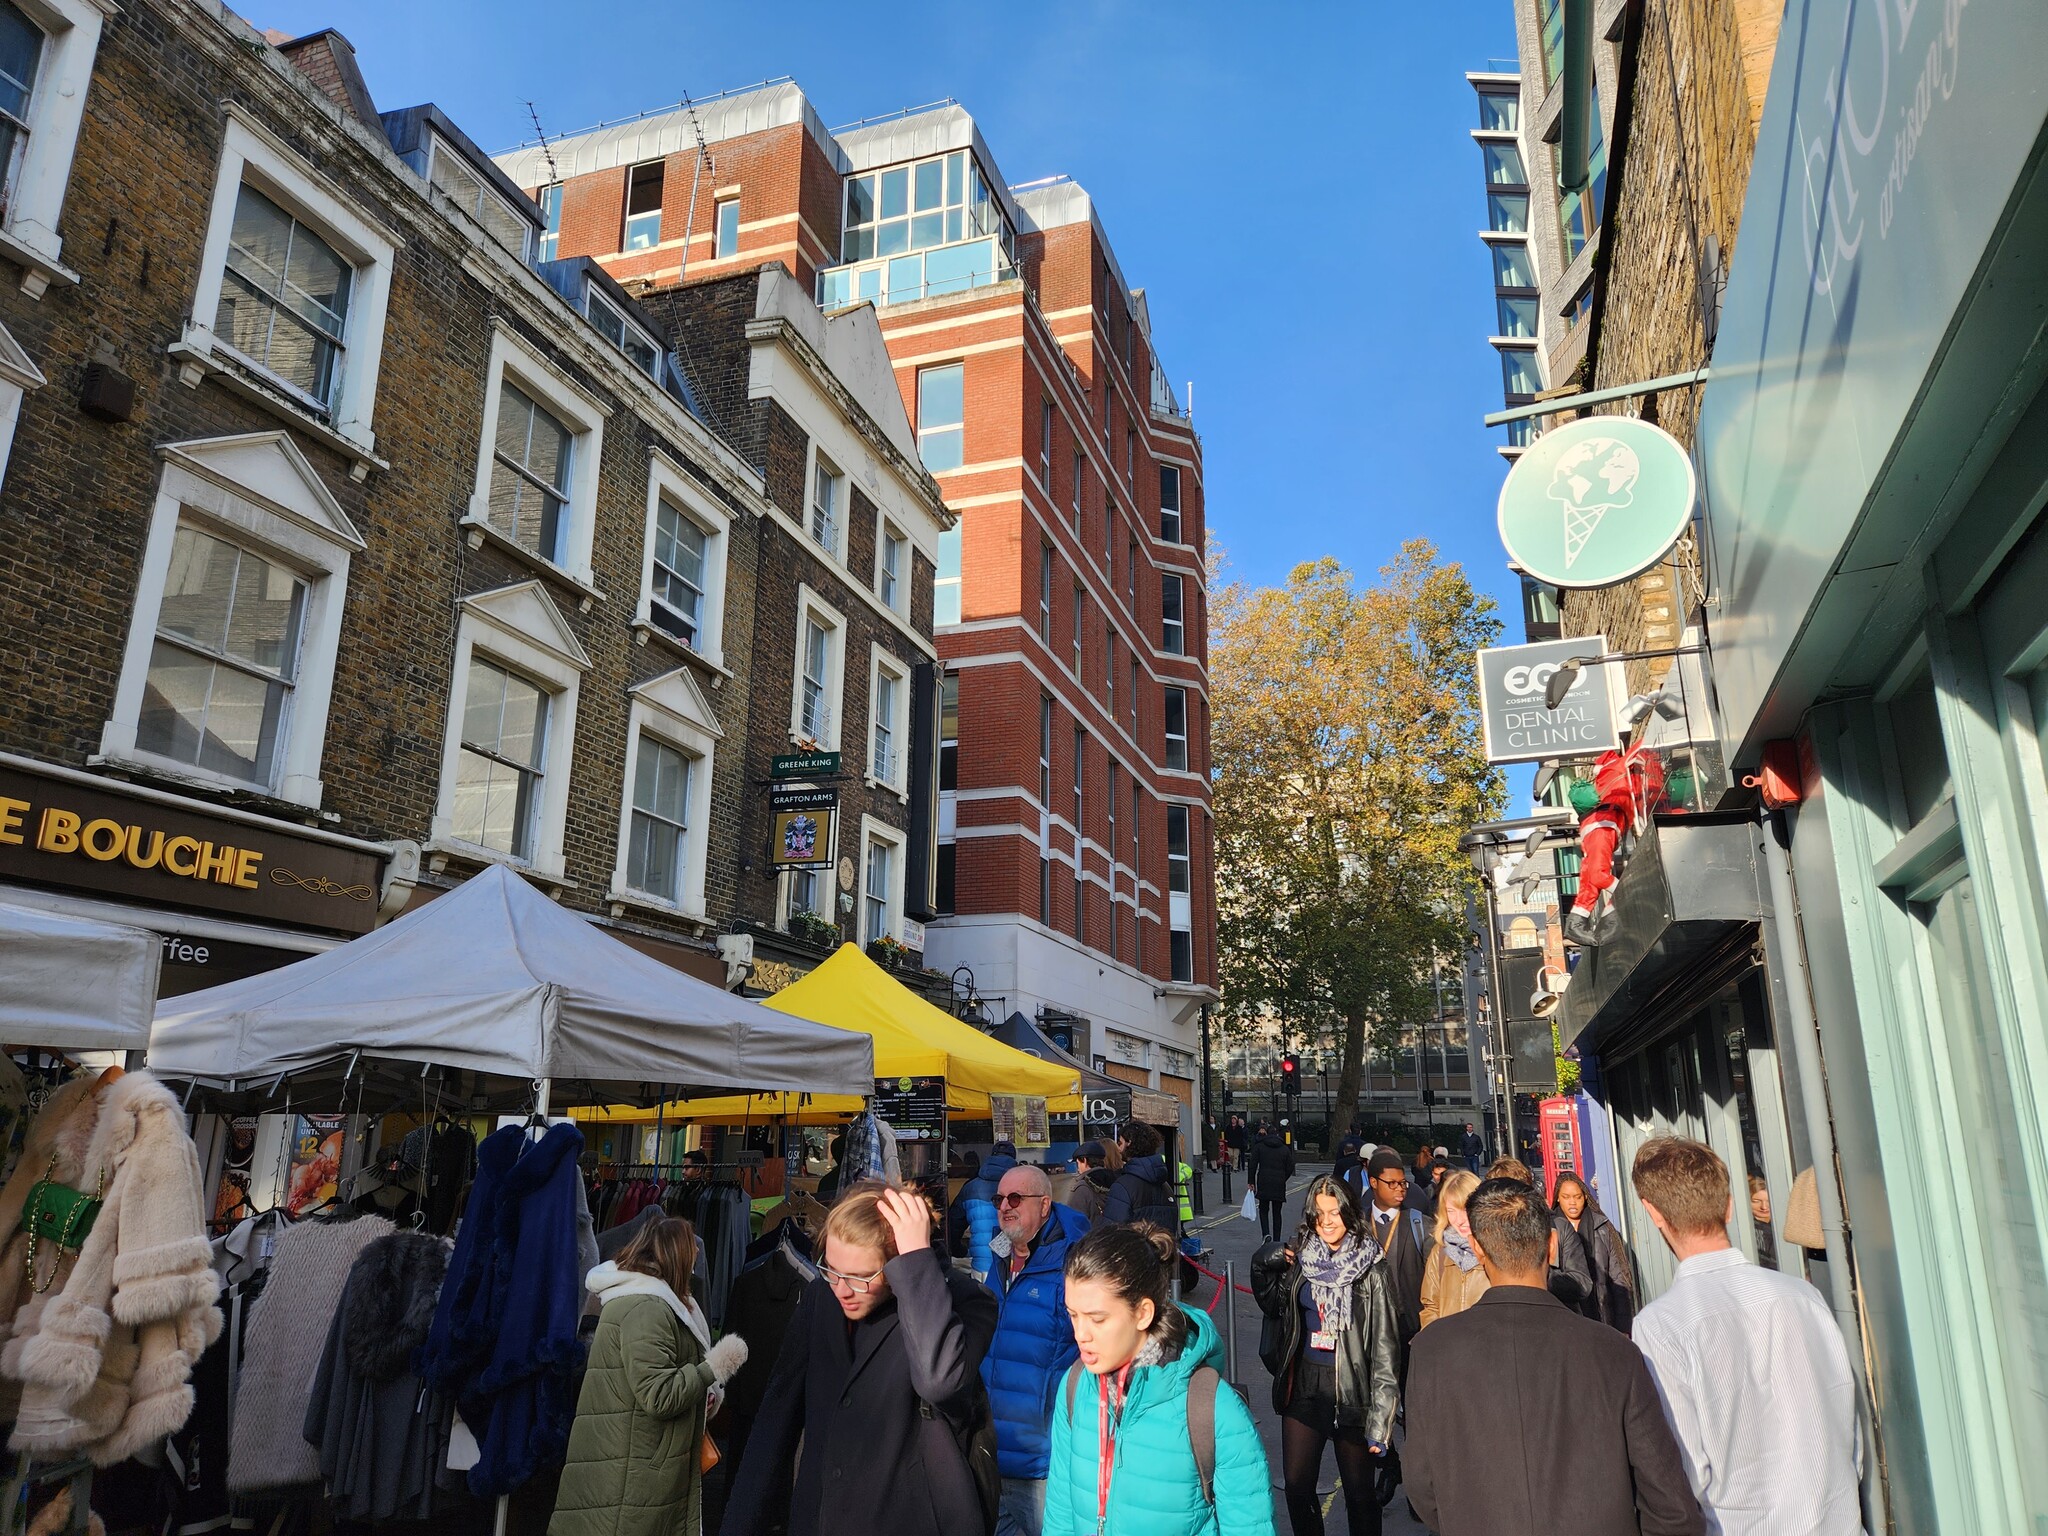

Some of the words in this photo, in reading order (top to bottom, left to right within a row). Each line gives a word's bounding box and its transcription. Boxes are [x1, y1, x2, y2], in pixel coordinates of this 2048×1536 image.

[1505, 695, 1546, 705] COSMETIC
[1505, 706, 1596, 730] DENTAL
[1508, 724, 1598, 748] CLINIC
[778, 760, 809, 770] GREENE
[811, 758, 832, 767] KING
[773, 795, 811, 804] GRAFTON
[812, 793, 833, 801] ARMS
[37, 807, 264, 889] BOUCHE
[302, 1121, 340, 1129] AVILABLE
[300, 1128, 320, 1136] UNTI
[299, 1136, 318, 1153] 12
